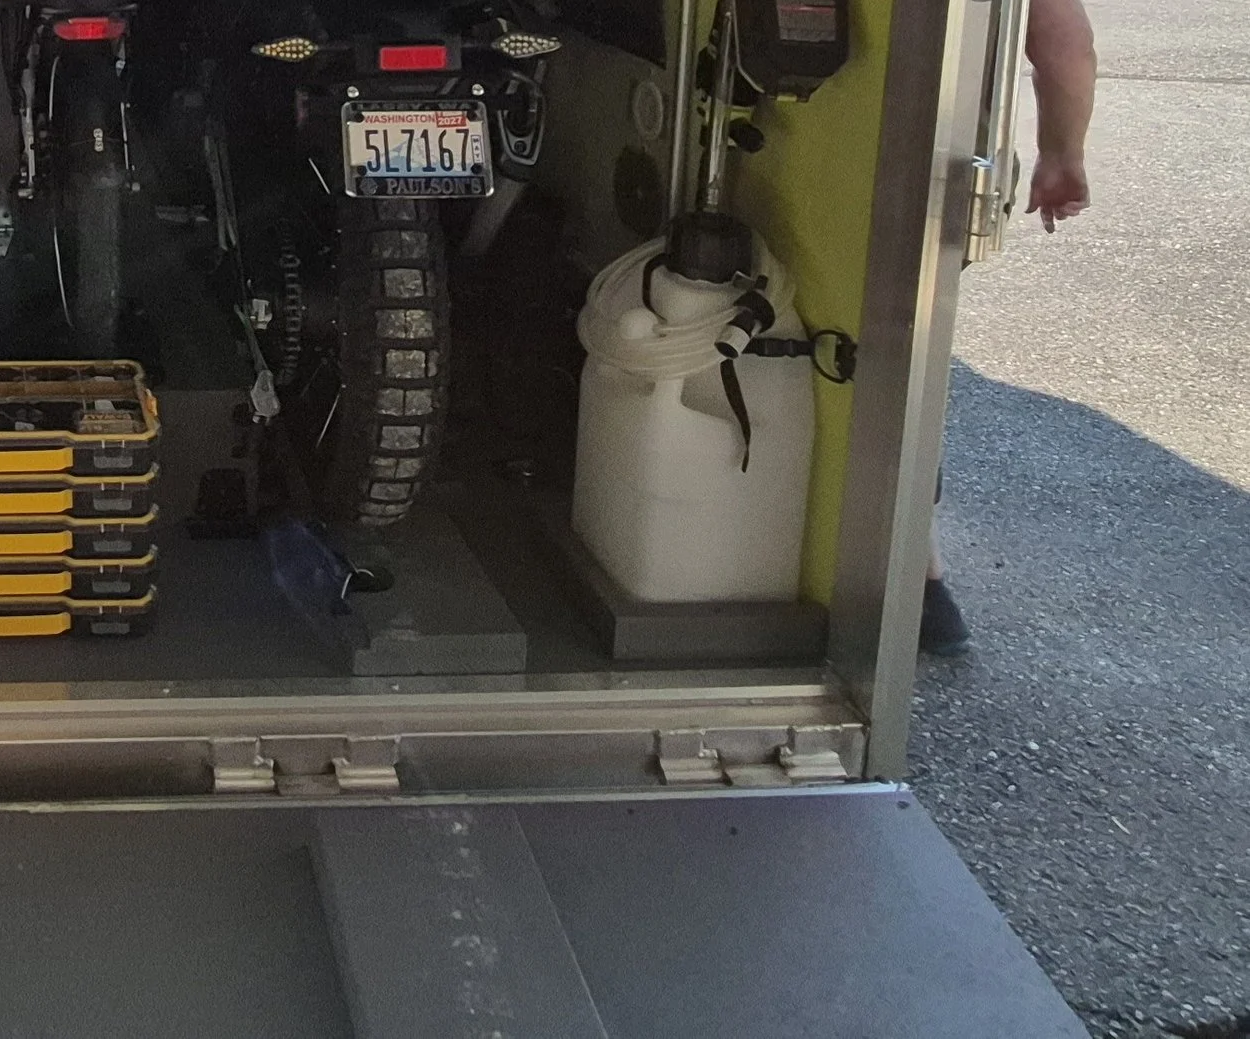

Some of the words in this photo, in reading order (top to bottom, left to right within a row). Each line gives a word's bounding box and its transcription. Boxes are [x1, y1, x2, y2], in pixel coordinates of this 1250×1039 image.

[365, 114, 436, 124] WASHINGTON
[438, 117, 464, 126] 2027
[365, 129, 469, 172] 5L7167
